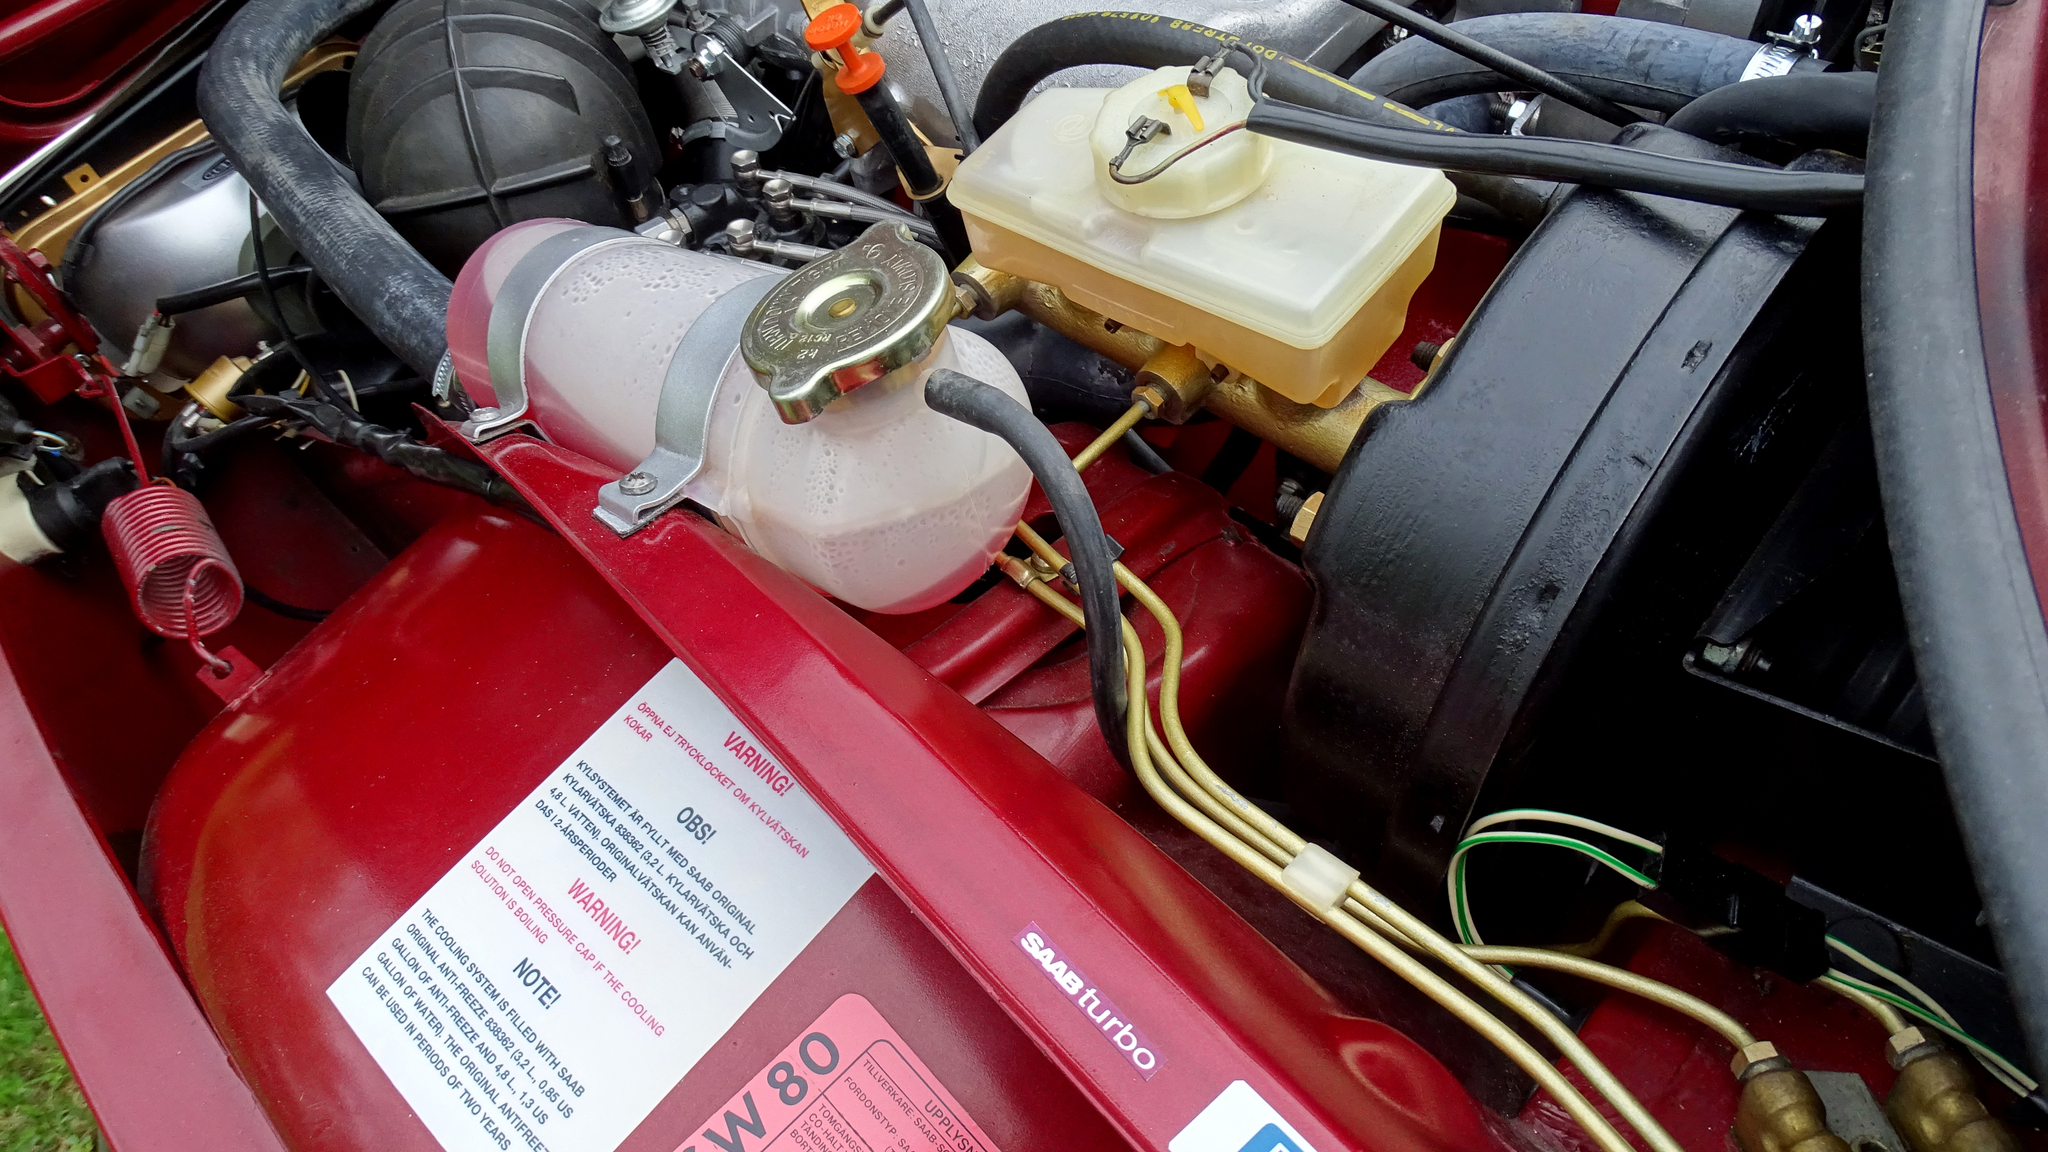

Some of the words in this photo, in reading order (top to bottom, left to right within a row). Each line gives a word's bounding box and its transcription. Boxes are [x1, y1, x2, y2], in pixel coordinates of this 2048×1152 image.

[622, 713, 653, 742] KOKAR
[636, 701, 665, 729] ÖPPNA
[661, 724, 677, 738] EJ
[673, 733, 736, 789] TRYCKLOCKET
[732, 787, 751, 805] OM
[747, 800, 810, 858] KYLVÄTSKAN
[722, 730, 794, 797] VARNING!
[534, 798, 554, 818] DAS
[549, 813, 558, 822] I
[552, 817, 617, 883] 2-ÅRSPERIODER
[575, 759, 633, 813] KYLSYSTEMET
[627, 808, 644, 826] ÄR
[639, 820, 670, 849] FYLLT
[665, 845, 689, 868] MED
[685, 865, 714, 892] SAAB
[710, 889, 756, 935] ORIGINAL
[675, 806, 717, 845] OBS!
[470, 859, 509, 901] SOLUTION
[504, 897, 517, 910] IS
[512, 906, 548, 944] BOILING
[549, 786, 563, 800] 4,8
[558, 795, 567, 808] L.
[567, 802, 601, 841] VATTEN).
[599, 836, 679, 915] ORIGINALVÄTSKAN
[674, 910, 699, 935] KAN
[694, 932, 732, 969] ANVÄN-
[561, 772, 617, 828] KYLARVÄTSKA
[613, 822, 644, 853] 838362
[639, 848, 659, 868] (3,2
[655, 863, 664, 877] L.
[664, 872, 730, 939] KYLARVÄTSKA
[728, 935, 755, 960] OCH
[566, 876, 642, 955] WARNING!
[484, 845, 500, 861] DO
[495, 857, 516, 877] NOT
[511, 874, 536, 901] OPEN
[531, 896, 578, 945] PRESSURE
[574, 941, 596, 961] CAP
[591, 960, 606, 971] IF
[602, 969, 624, 993] THE
[620, 990, 665, 1037] COOLING
[511, 956, 562, 1010] NOTE!
[376, 951, 407, 988] GALLON
[402, 984, 418, 999] OF
[412, 996, 445, 1038] WATER).
[442, 1033, 464, 1058] THE
[458, 1054, 500, 1105] ORIGINAL
[497, 1101, 551, 1152] ANTIFREE
[390, 936, 422, 974] GALLON
[417, 969, 433, 984] OF
[426, 983, 480, 1044] ANTI-FREEZE
[474, 1041, 497, 1065] AND
[494, 1063, 510, 1081] 4,8
[505, 1076, 516, 1095] L.,
[518, 1090, 535, 1109] 1,3
[531, 1104, 549, 1125] US
[405, 922, 440, 965] ORIGINAL
[435, 961, 489, 1021] ANTI-FREEZE
[483, 1016, 515, 1052] 838362
[509, 1047, 530, 1070] (3,2
[525, 1064, 536, 1084] L.,
[537, 1078, 560, 1103] 0,85
[556, 1098, 574, 1119] US
[420, 907, 439, 929] THE
[433, 924, 470, 966] COOLING
[465, 961, 501, 1002] SYSTEM
[495, 997, 509, 1012] IS
[504, 1007, 537, 1044] FILLED
[533, 1039, 561, 1070] WITH
[556, 1066, 585, 1098] SAAB
[1020, 931, 1085, 996] SAAB
[1077, 987, 1156, 1070] turbo
[361, 965, 380, 988] CAN
[374, 983, 390, 1001] BE
[384, 995, 408, 1024] USED
[403, 1020, 418, 1036] IN
[411, 1031, 450, 1077] PERIODS
[446, 1073, 463, 1090] OF
[458, 1087, 482, 1116] TWO
[478, 1111, 511, 1150] YEARS
[844, 1076, 898, 1140] FORDONSTYP:
[863, 1058, 915, 1120] TILLVERKARE:
